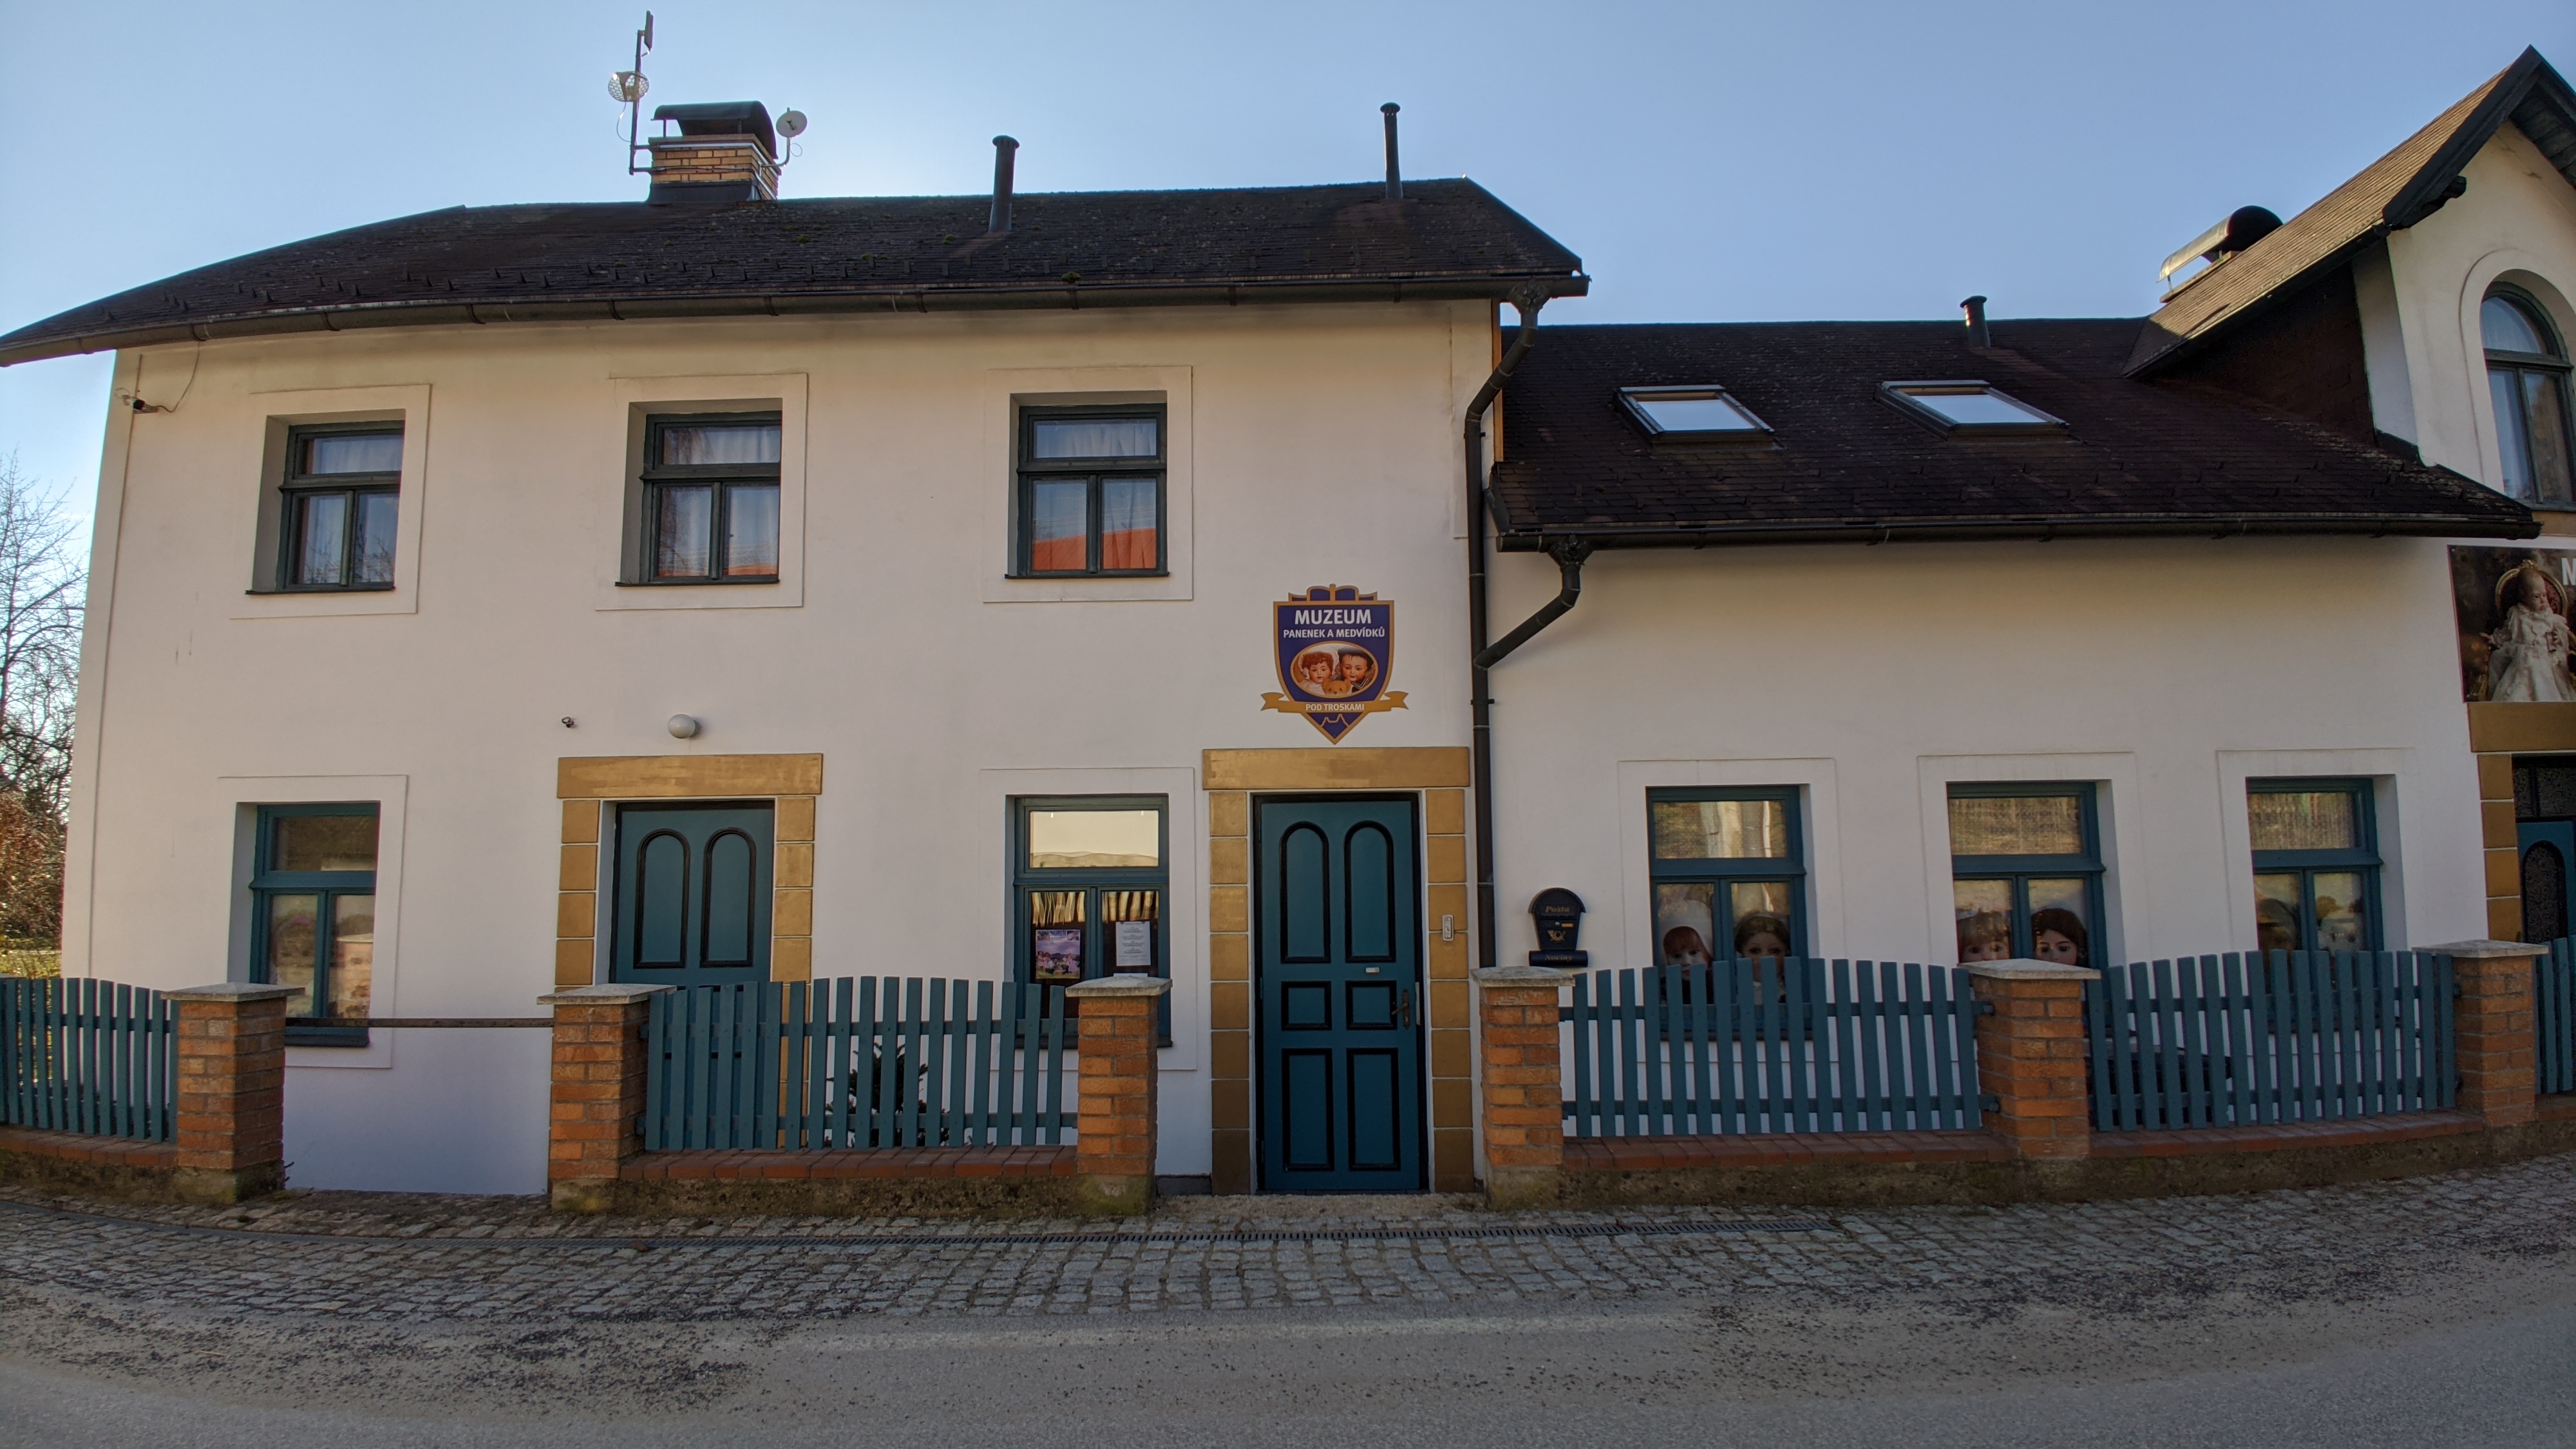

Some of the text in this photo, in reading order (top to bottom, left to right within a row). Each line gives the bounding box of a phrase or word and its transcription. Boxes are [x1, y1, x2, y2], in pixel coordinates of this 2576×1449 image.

[1294, 609, 1372, 625] MUZEUM
[1283, 626, 1385, 638] PANENEK A MEDVÍDKŮ
